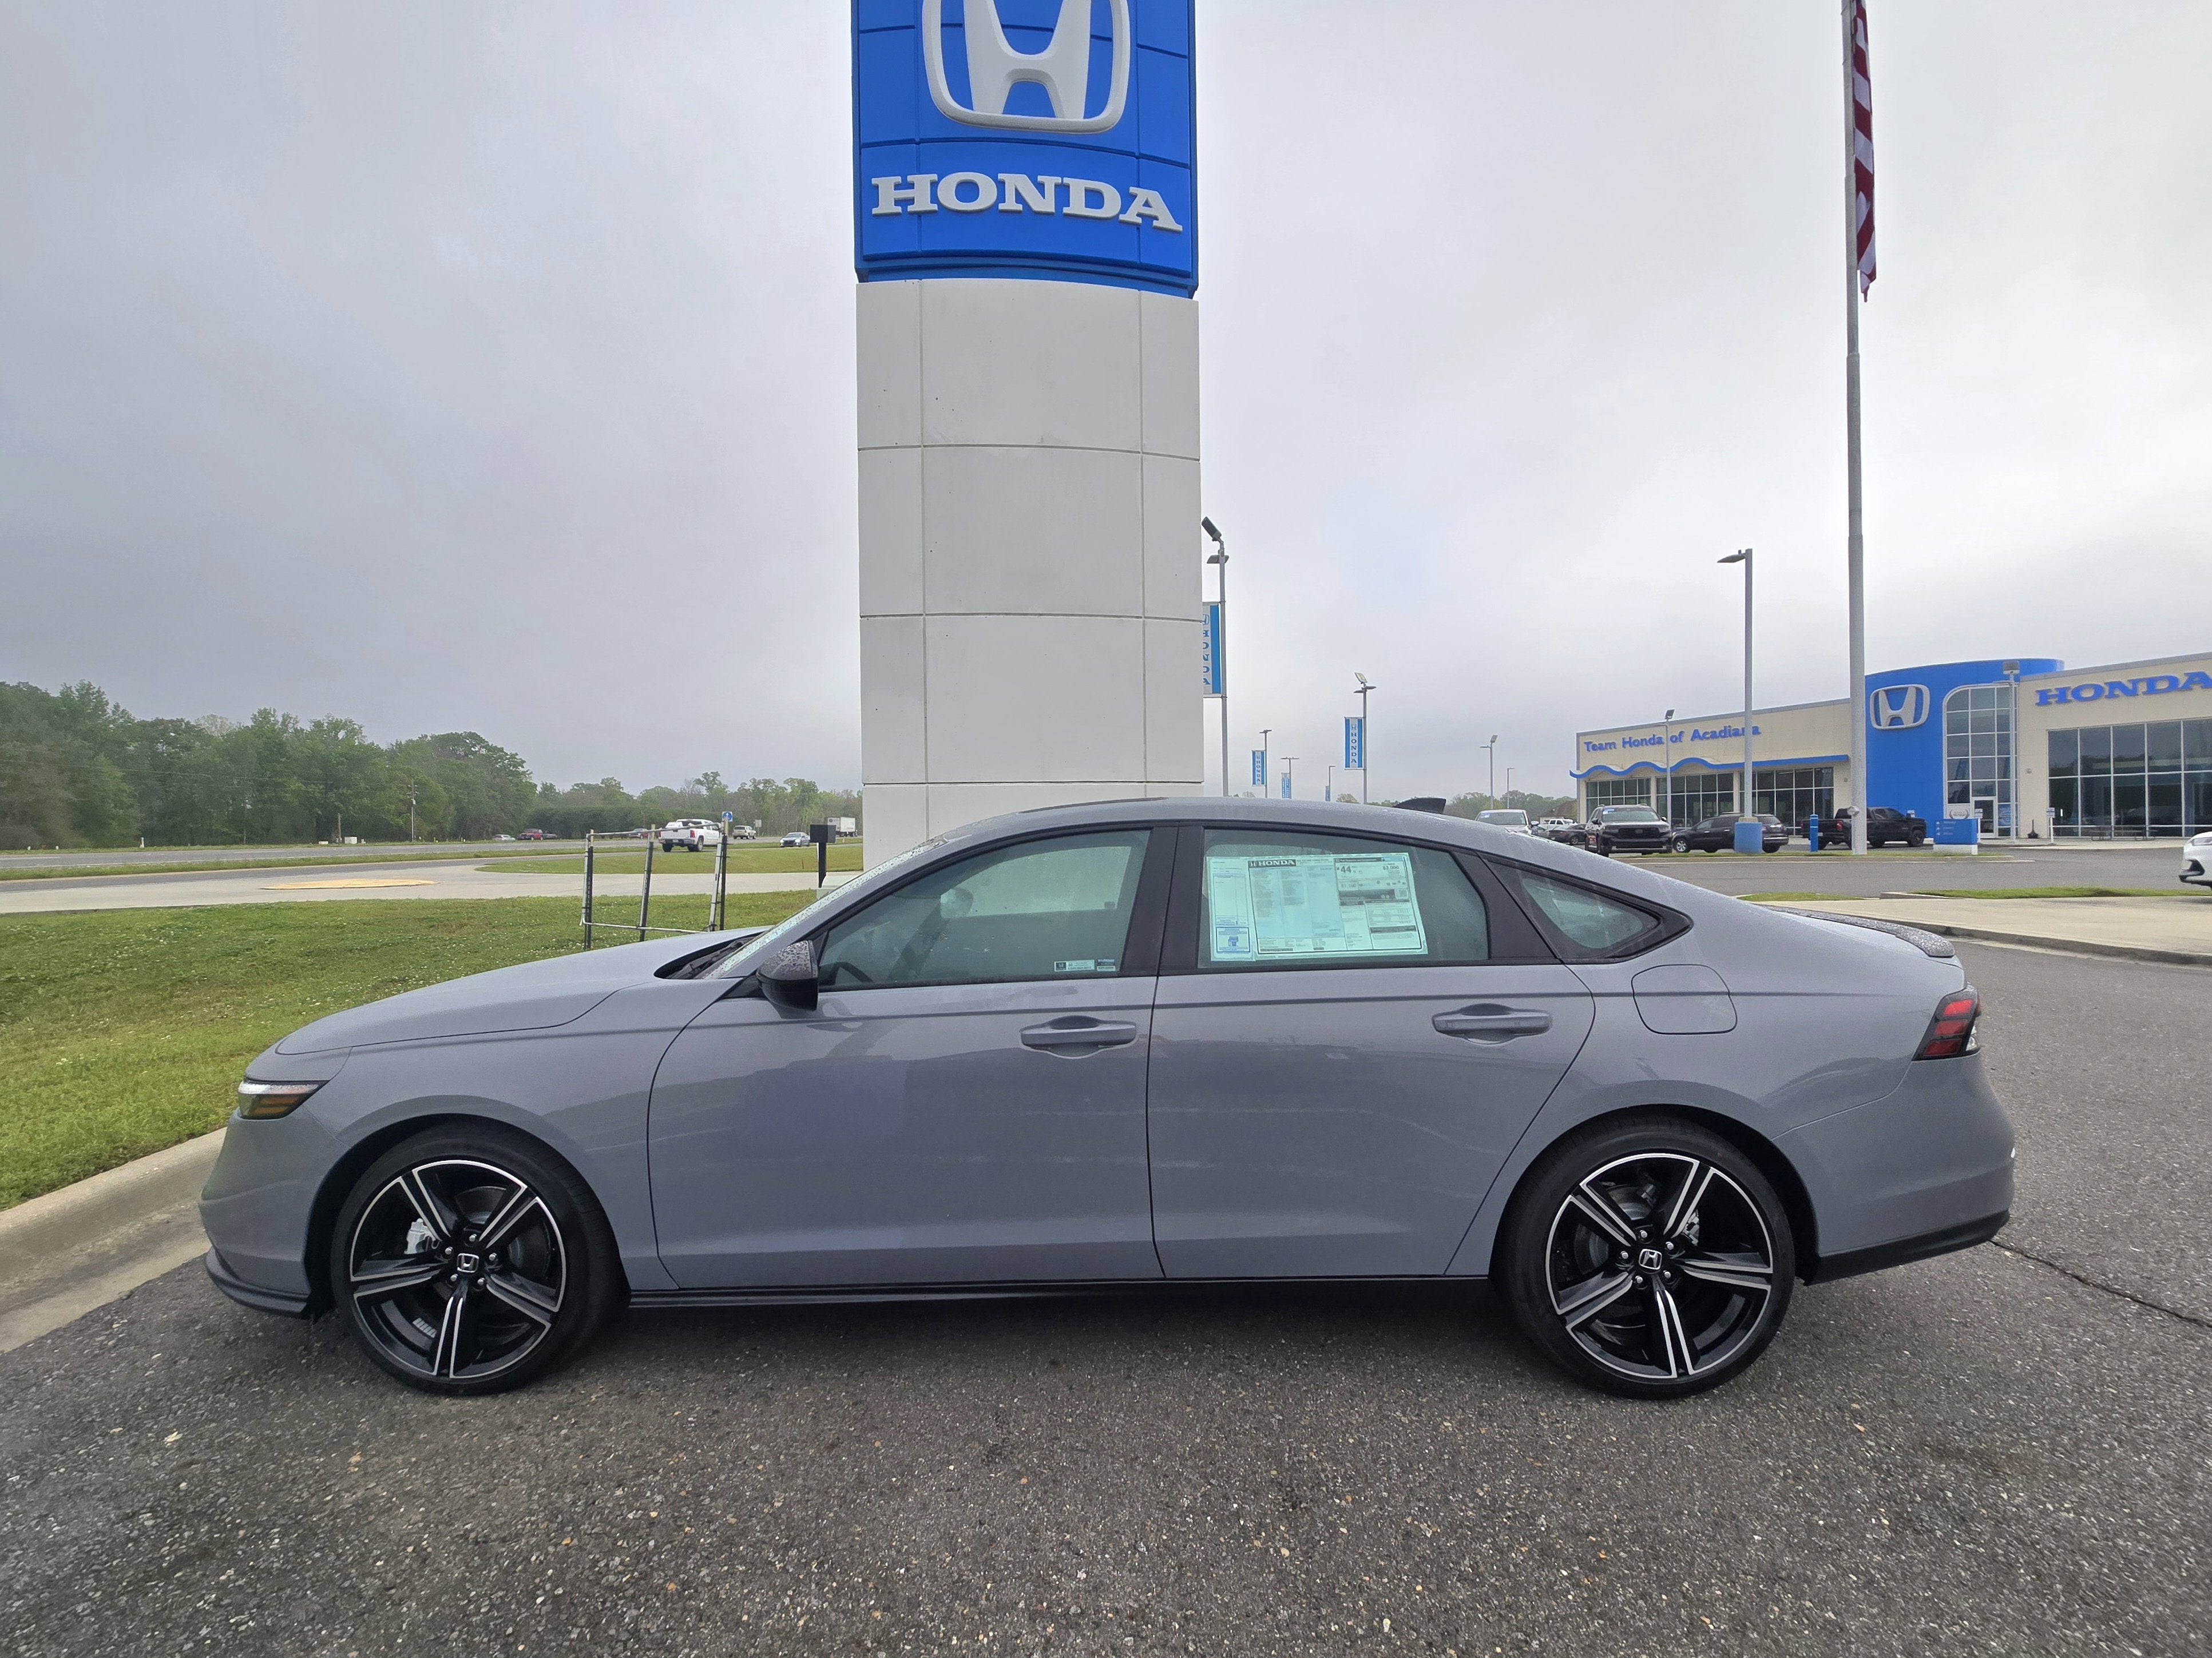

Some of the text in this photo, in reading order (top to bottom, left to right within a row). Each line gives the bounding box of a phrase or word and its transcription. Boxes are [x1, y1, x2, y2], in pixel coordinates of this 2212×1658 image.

[871, 172, 1183, 232] HONDA
[2035, 671, 2212, 706] HONDA
[1584, 741, 1616, 752] Team
[1622, 734, 1664, 748] Honda
[1670, 731, 1684, 743] of
